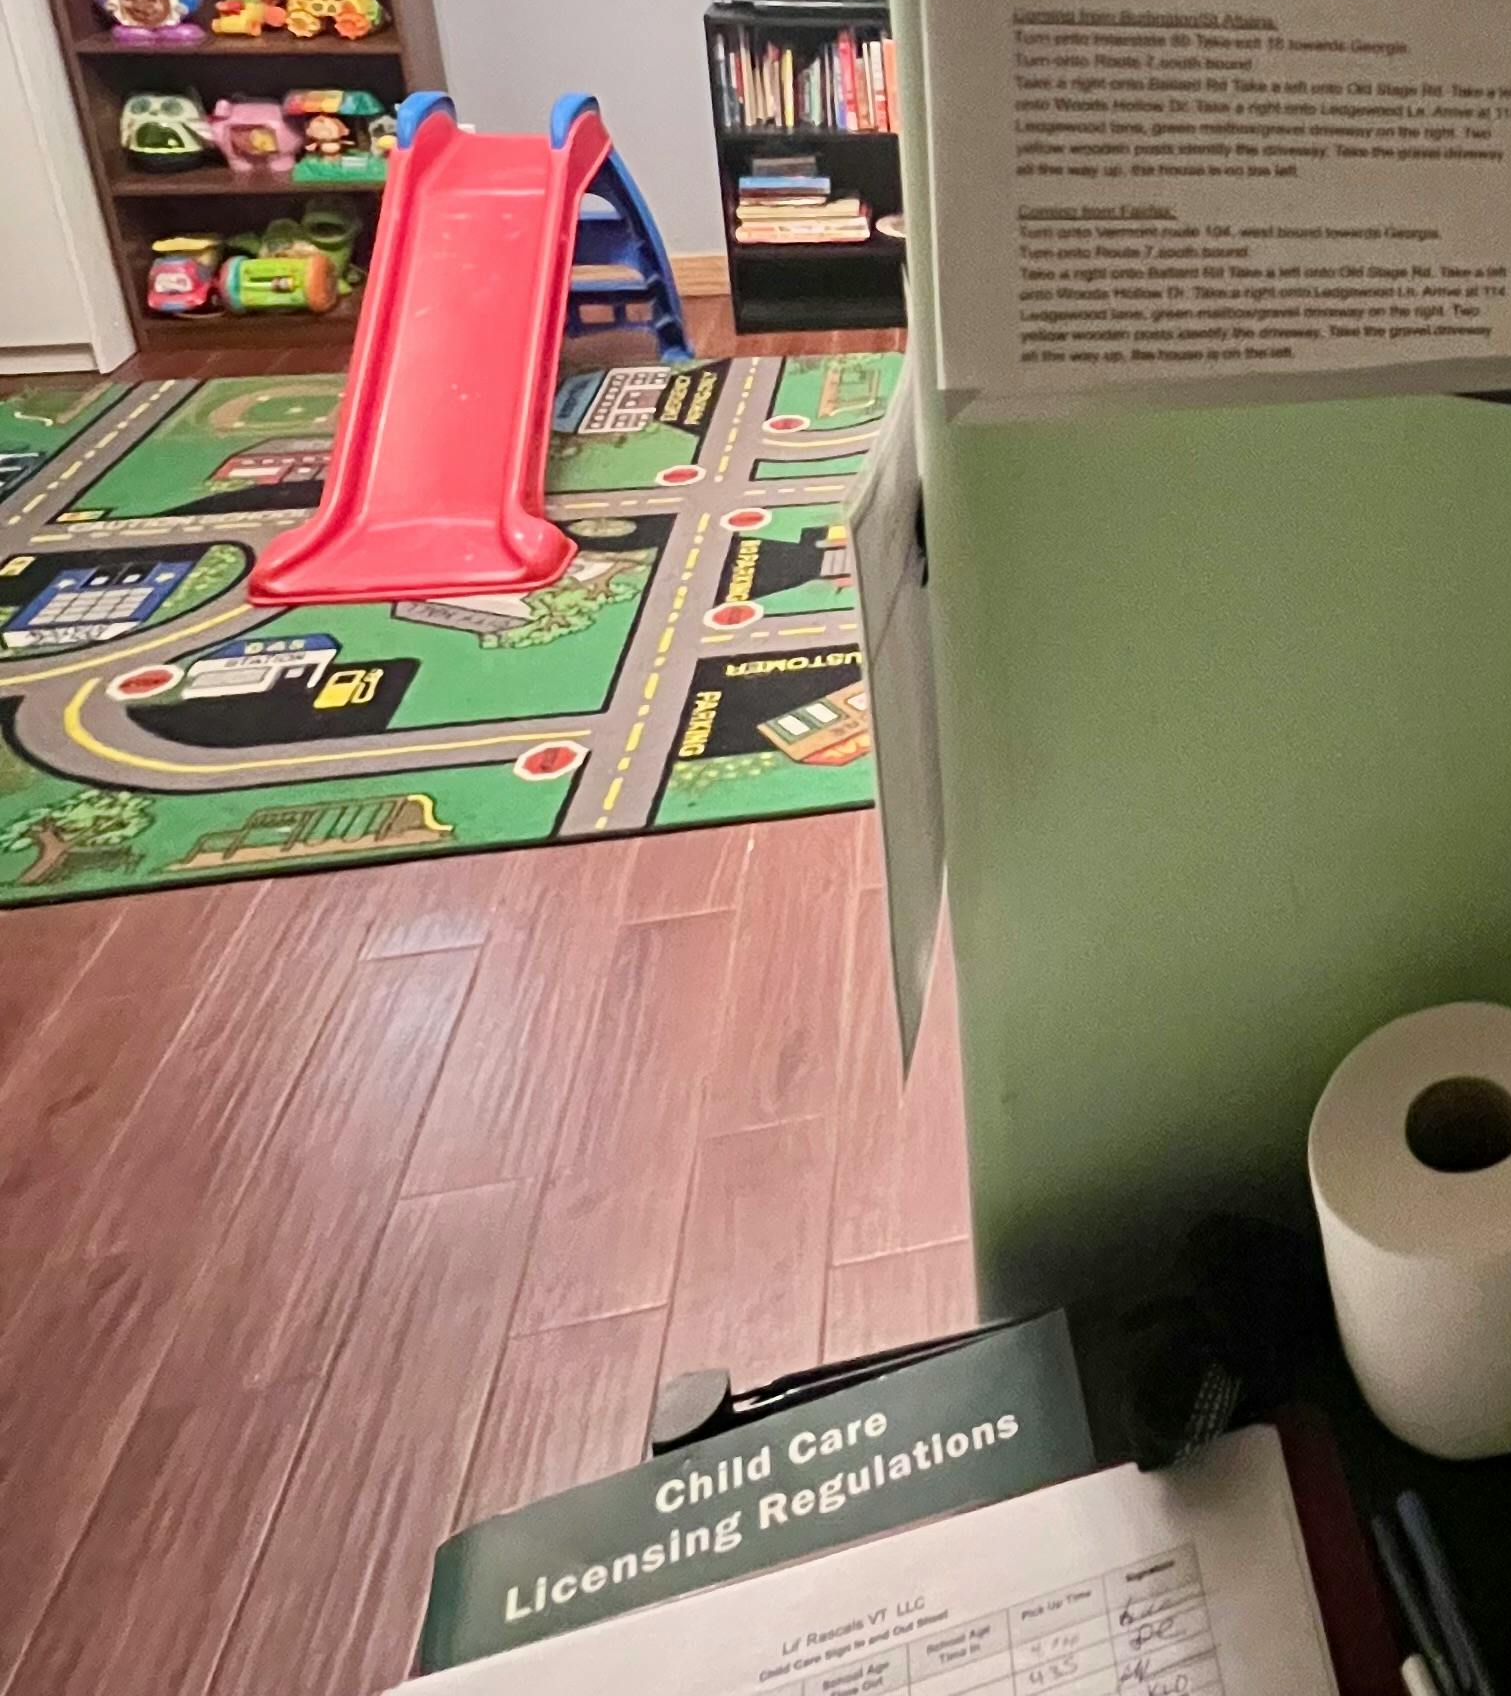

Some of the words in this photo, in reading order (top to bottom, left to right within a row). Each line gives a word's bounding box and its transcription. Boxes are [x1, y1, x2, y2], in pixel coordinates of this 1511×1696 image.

[725, 553, 760, 603] PARKING
[680, 690, 723, 757] PARKING
[652, 1444, 771, 1516] Child
[788, 1407, 890, 1467] Care
[502, 1507, 744, 1622] Licensing
[758, 1410, 1021, 1532] Regulations
[806, 1614, 866, 1649] Rascals
[867, 1607, 889, 1631] VT
[896, 1596, 926, 1623] LLC
[758, 1664, 792, 1683] Child
[793, 1655, 822, 1671] Care
